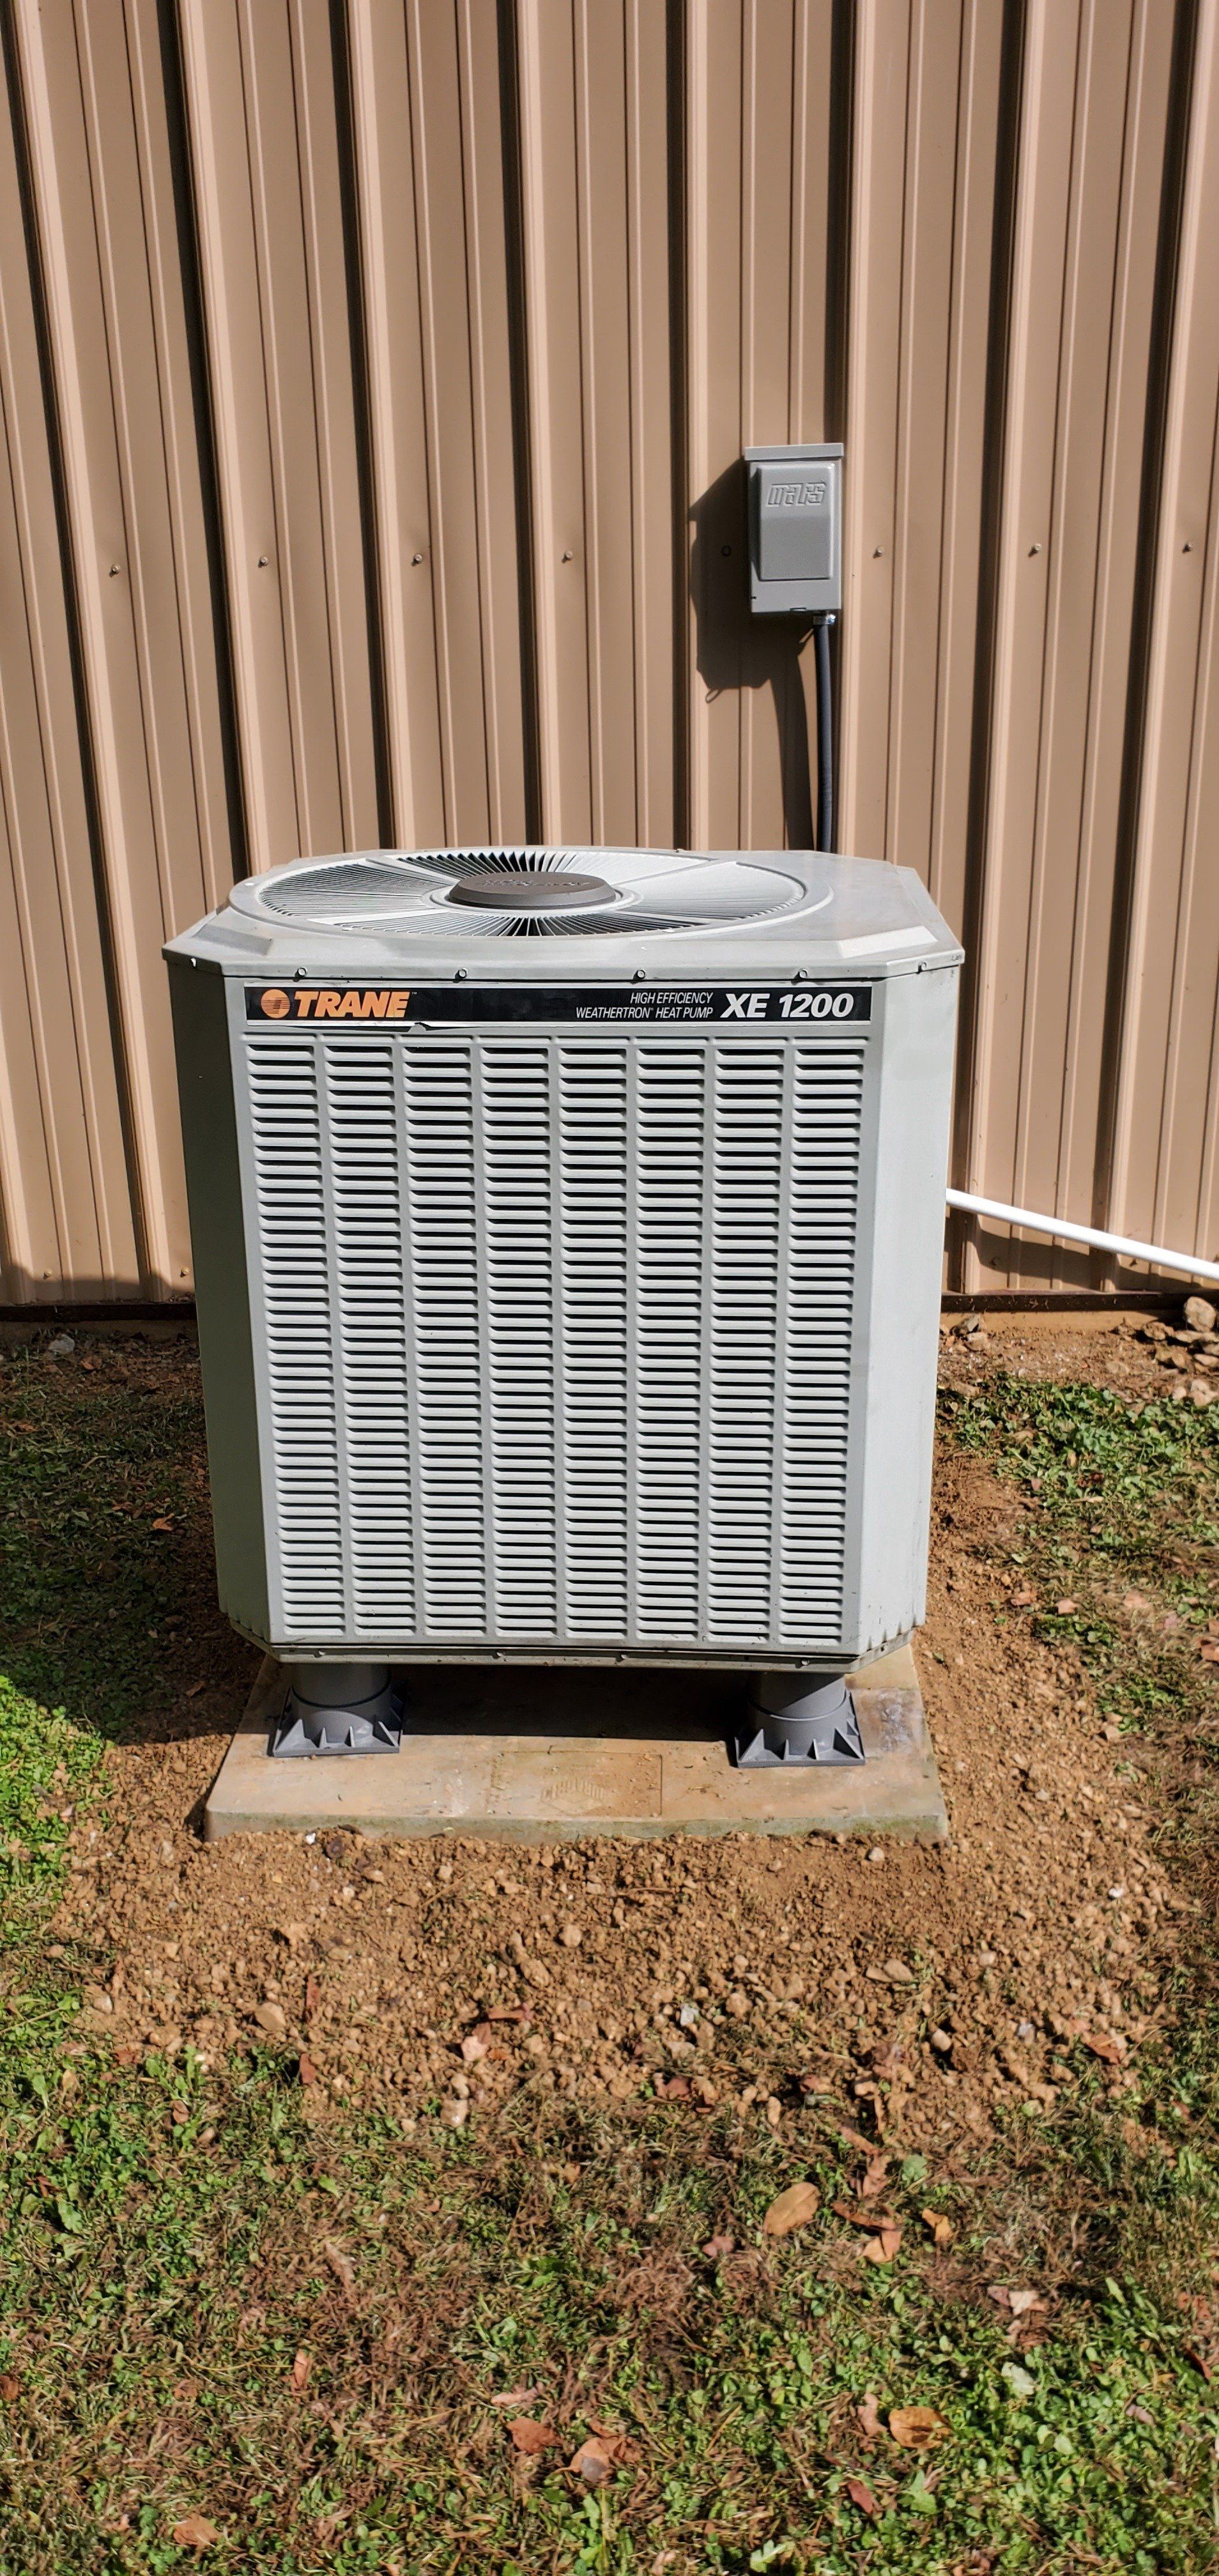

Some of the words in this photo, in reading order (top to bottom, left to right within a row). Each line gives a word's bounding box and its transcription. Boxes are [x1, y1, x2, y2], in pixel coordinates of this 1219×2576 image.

[294, 991, 410, 1018] TRANE
[630, 992, 656, 1004] HIGH
[657, 992, 714, 1004] EFFICIENCY
[720, 993, 770, 1018] XE
[779, 993, 854, 1018] 1200
[656, 1007, 682, 1018] HEAT
[683, 1007, 714, 1018] PUMP
